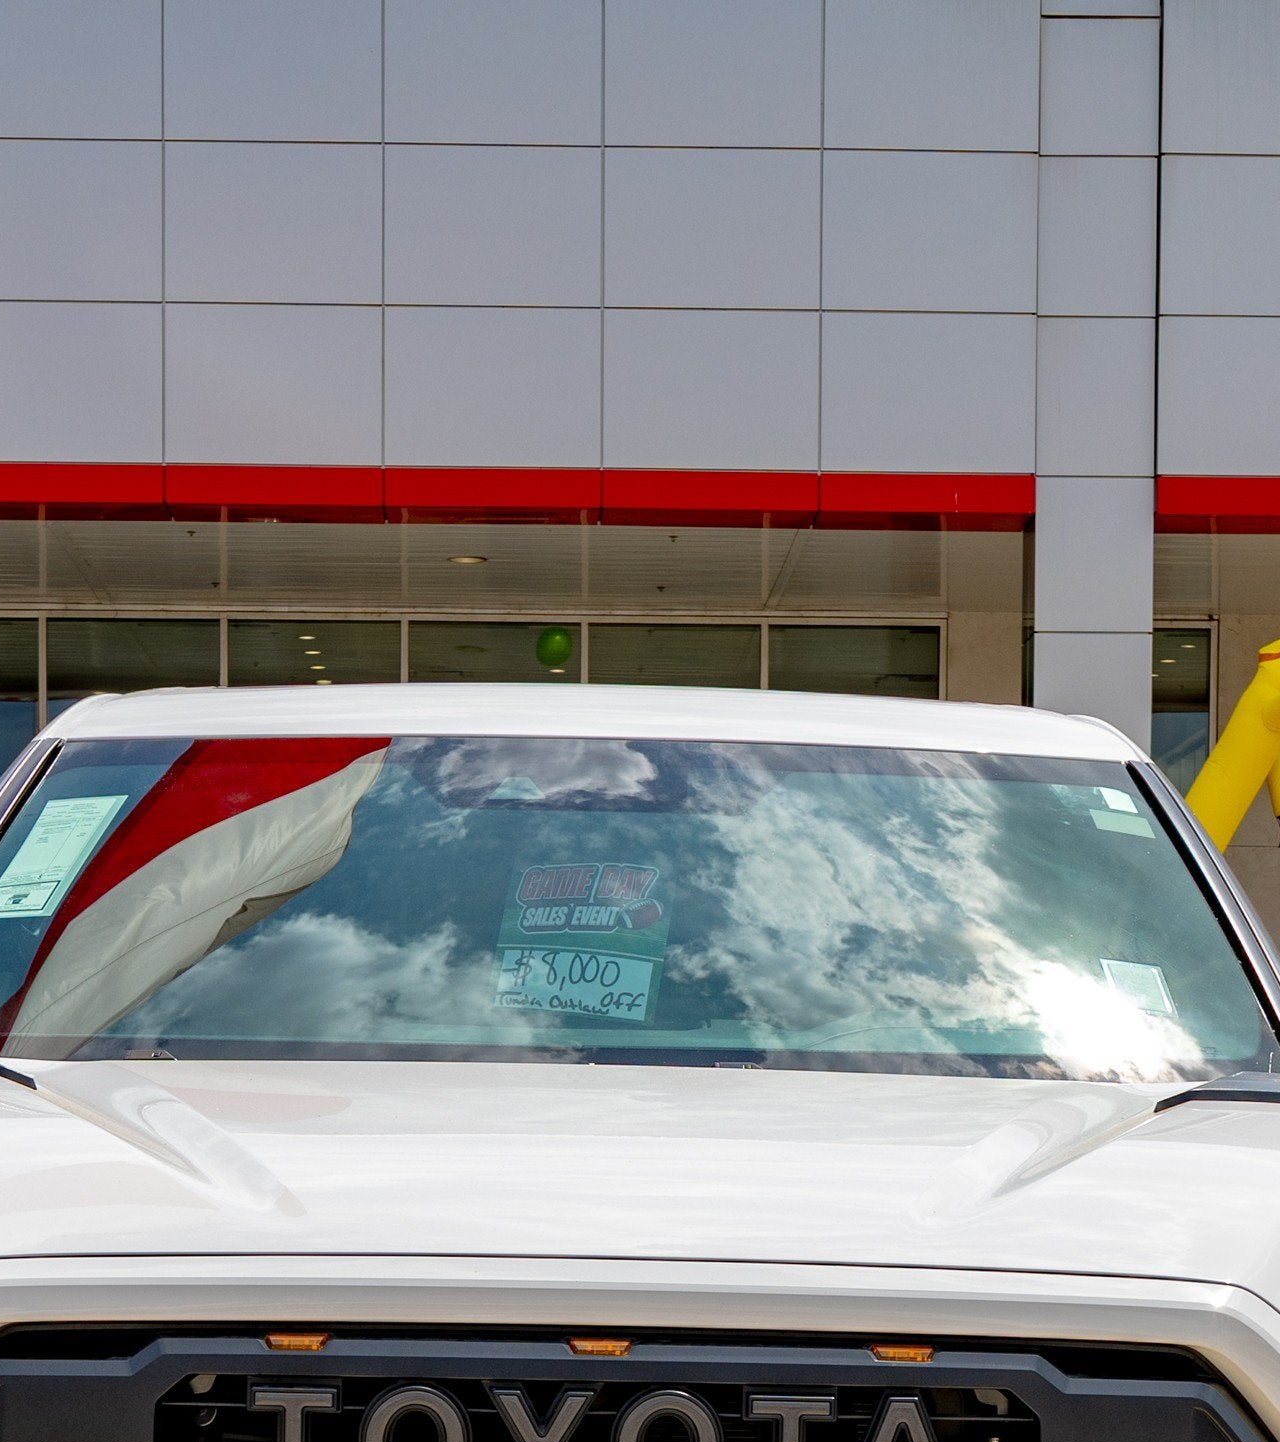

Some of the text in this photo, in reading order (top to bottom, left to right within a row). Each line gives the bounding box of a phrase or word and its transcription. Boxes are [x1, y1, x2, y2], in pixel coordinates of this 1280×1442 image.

[520, 867, 655, 901] GAME DAY
[523, 905, 620, 926] SALES EVENT
